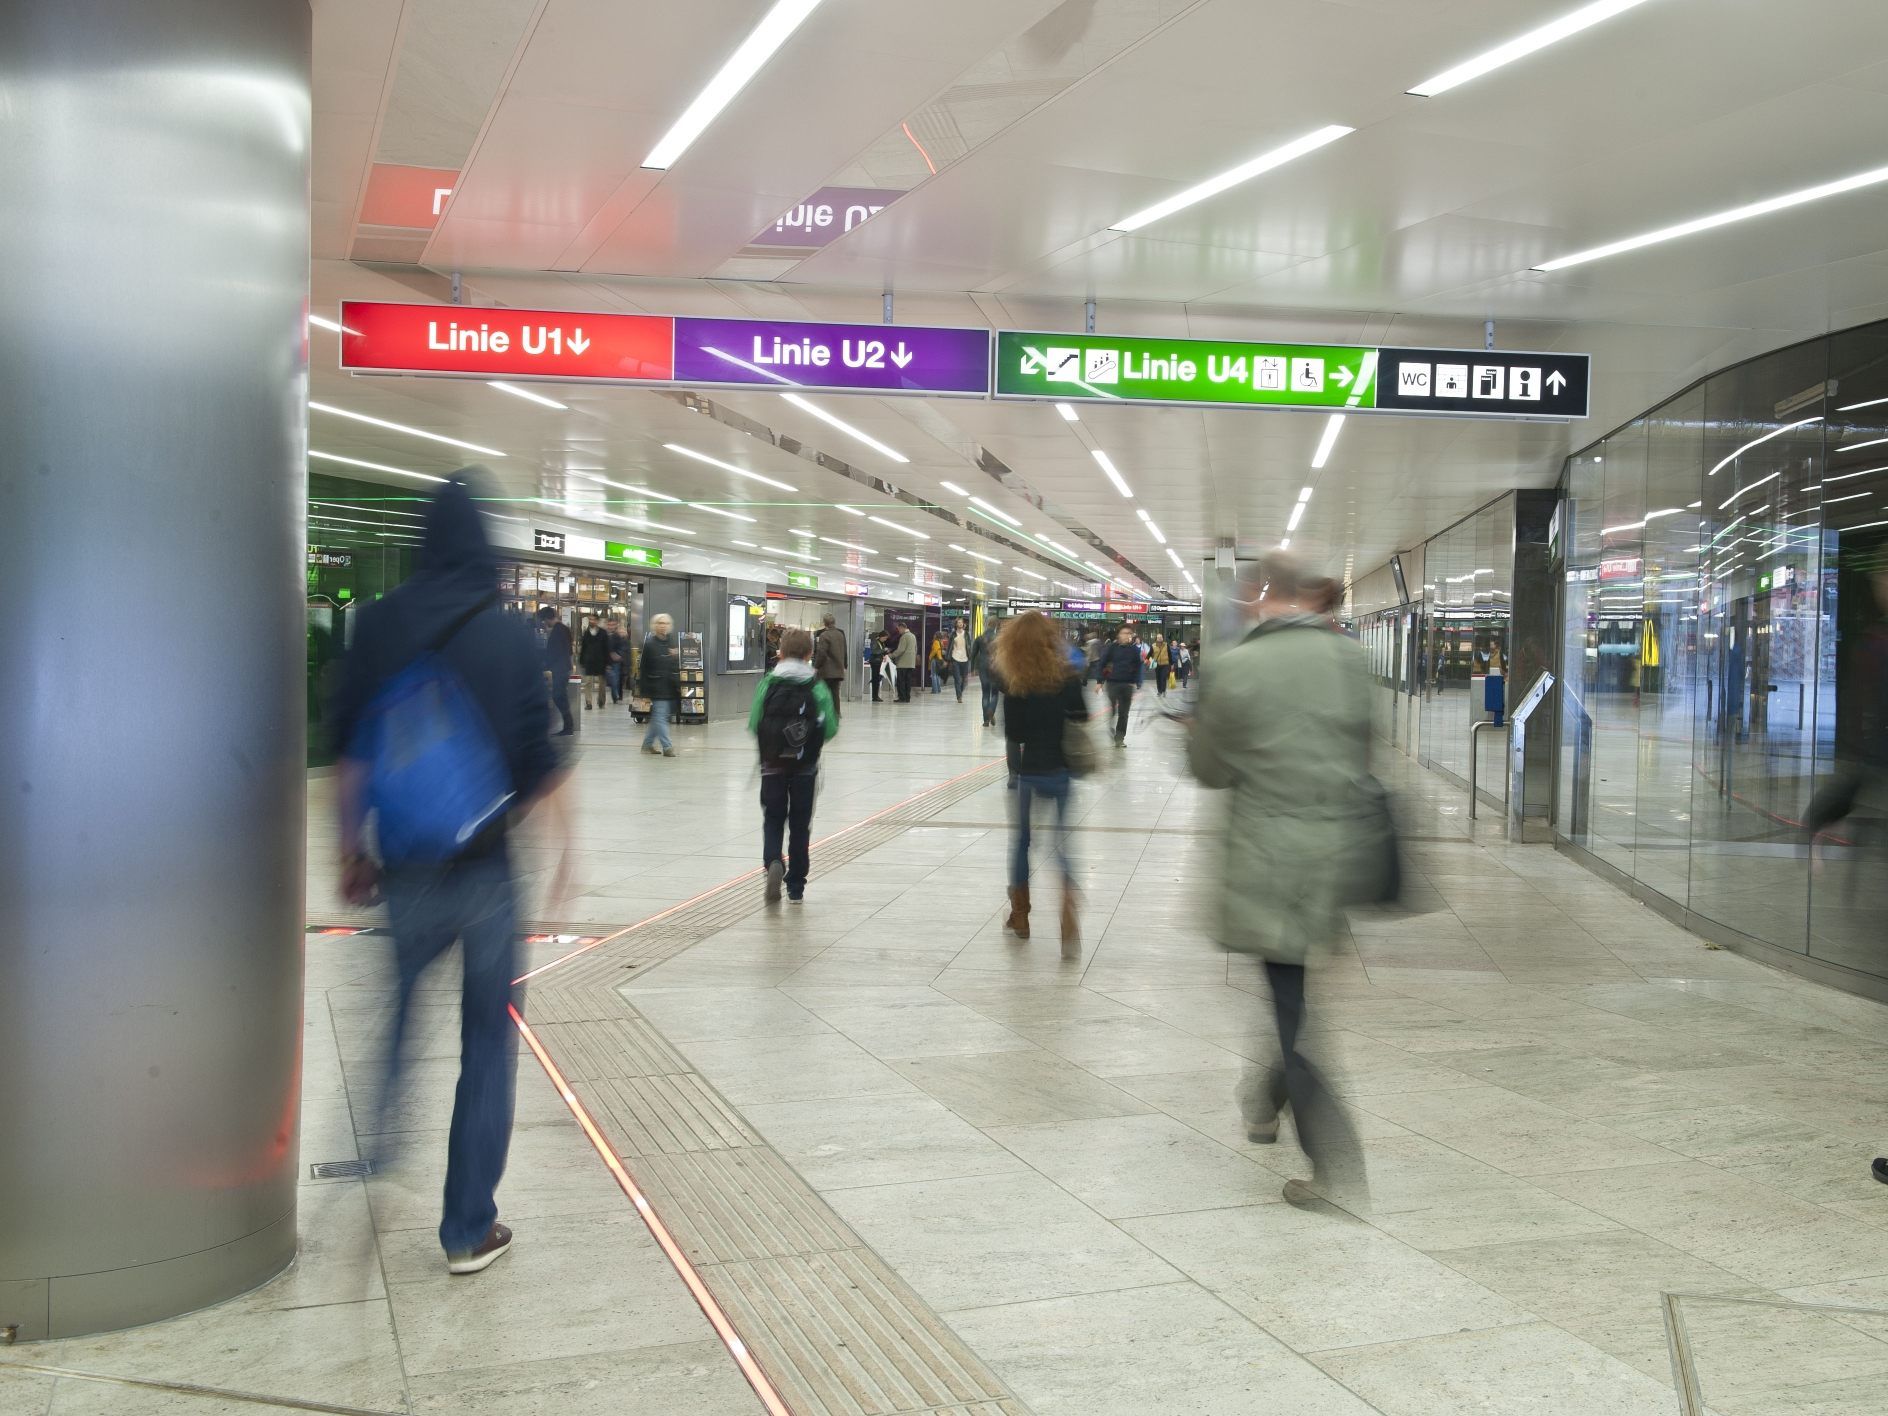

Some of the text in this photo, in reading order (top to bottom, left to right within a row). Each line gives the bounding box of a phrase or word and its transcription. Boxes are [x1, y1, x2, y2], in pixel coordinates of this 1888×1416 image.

[428, 321, 562, 355] Linie U1
[753, 335, 885, 369] Linie U2
[1123, 351, 1248, 384] Linie U4
[1402, 372, 1427, 387] WC
